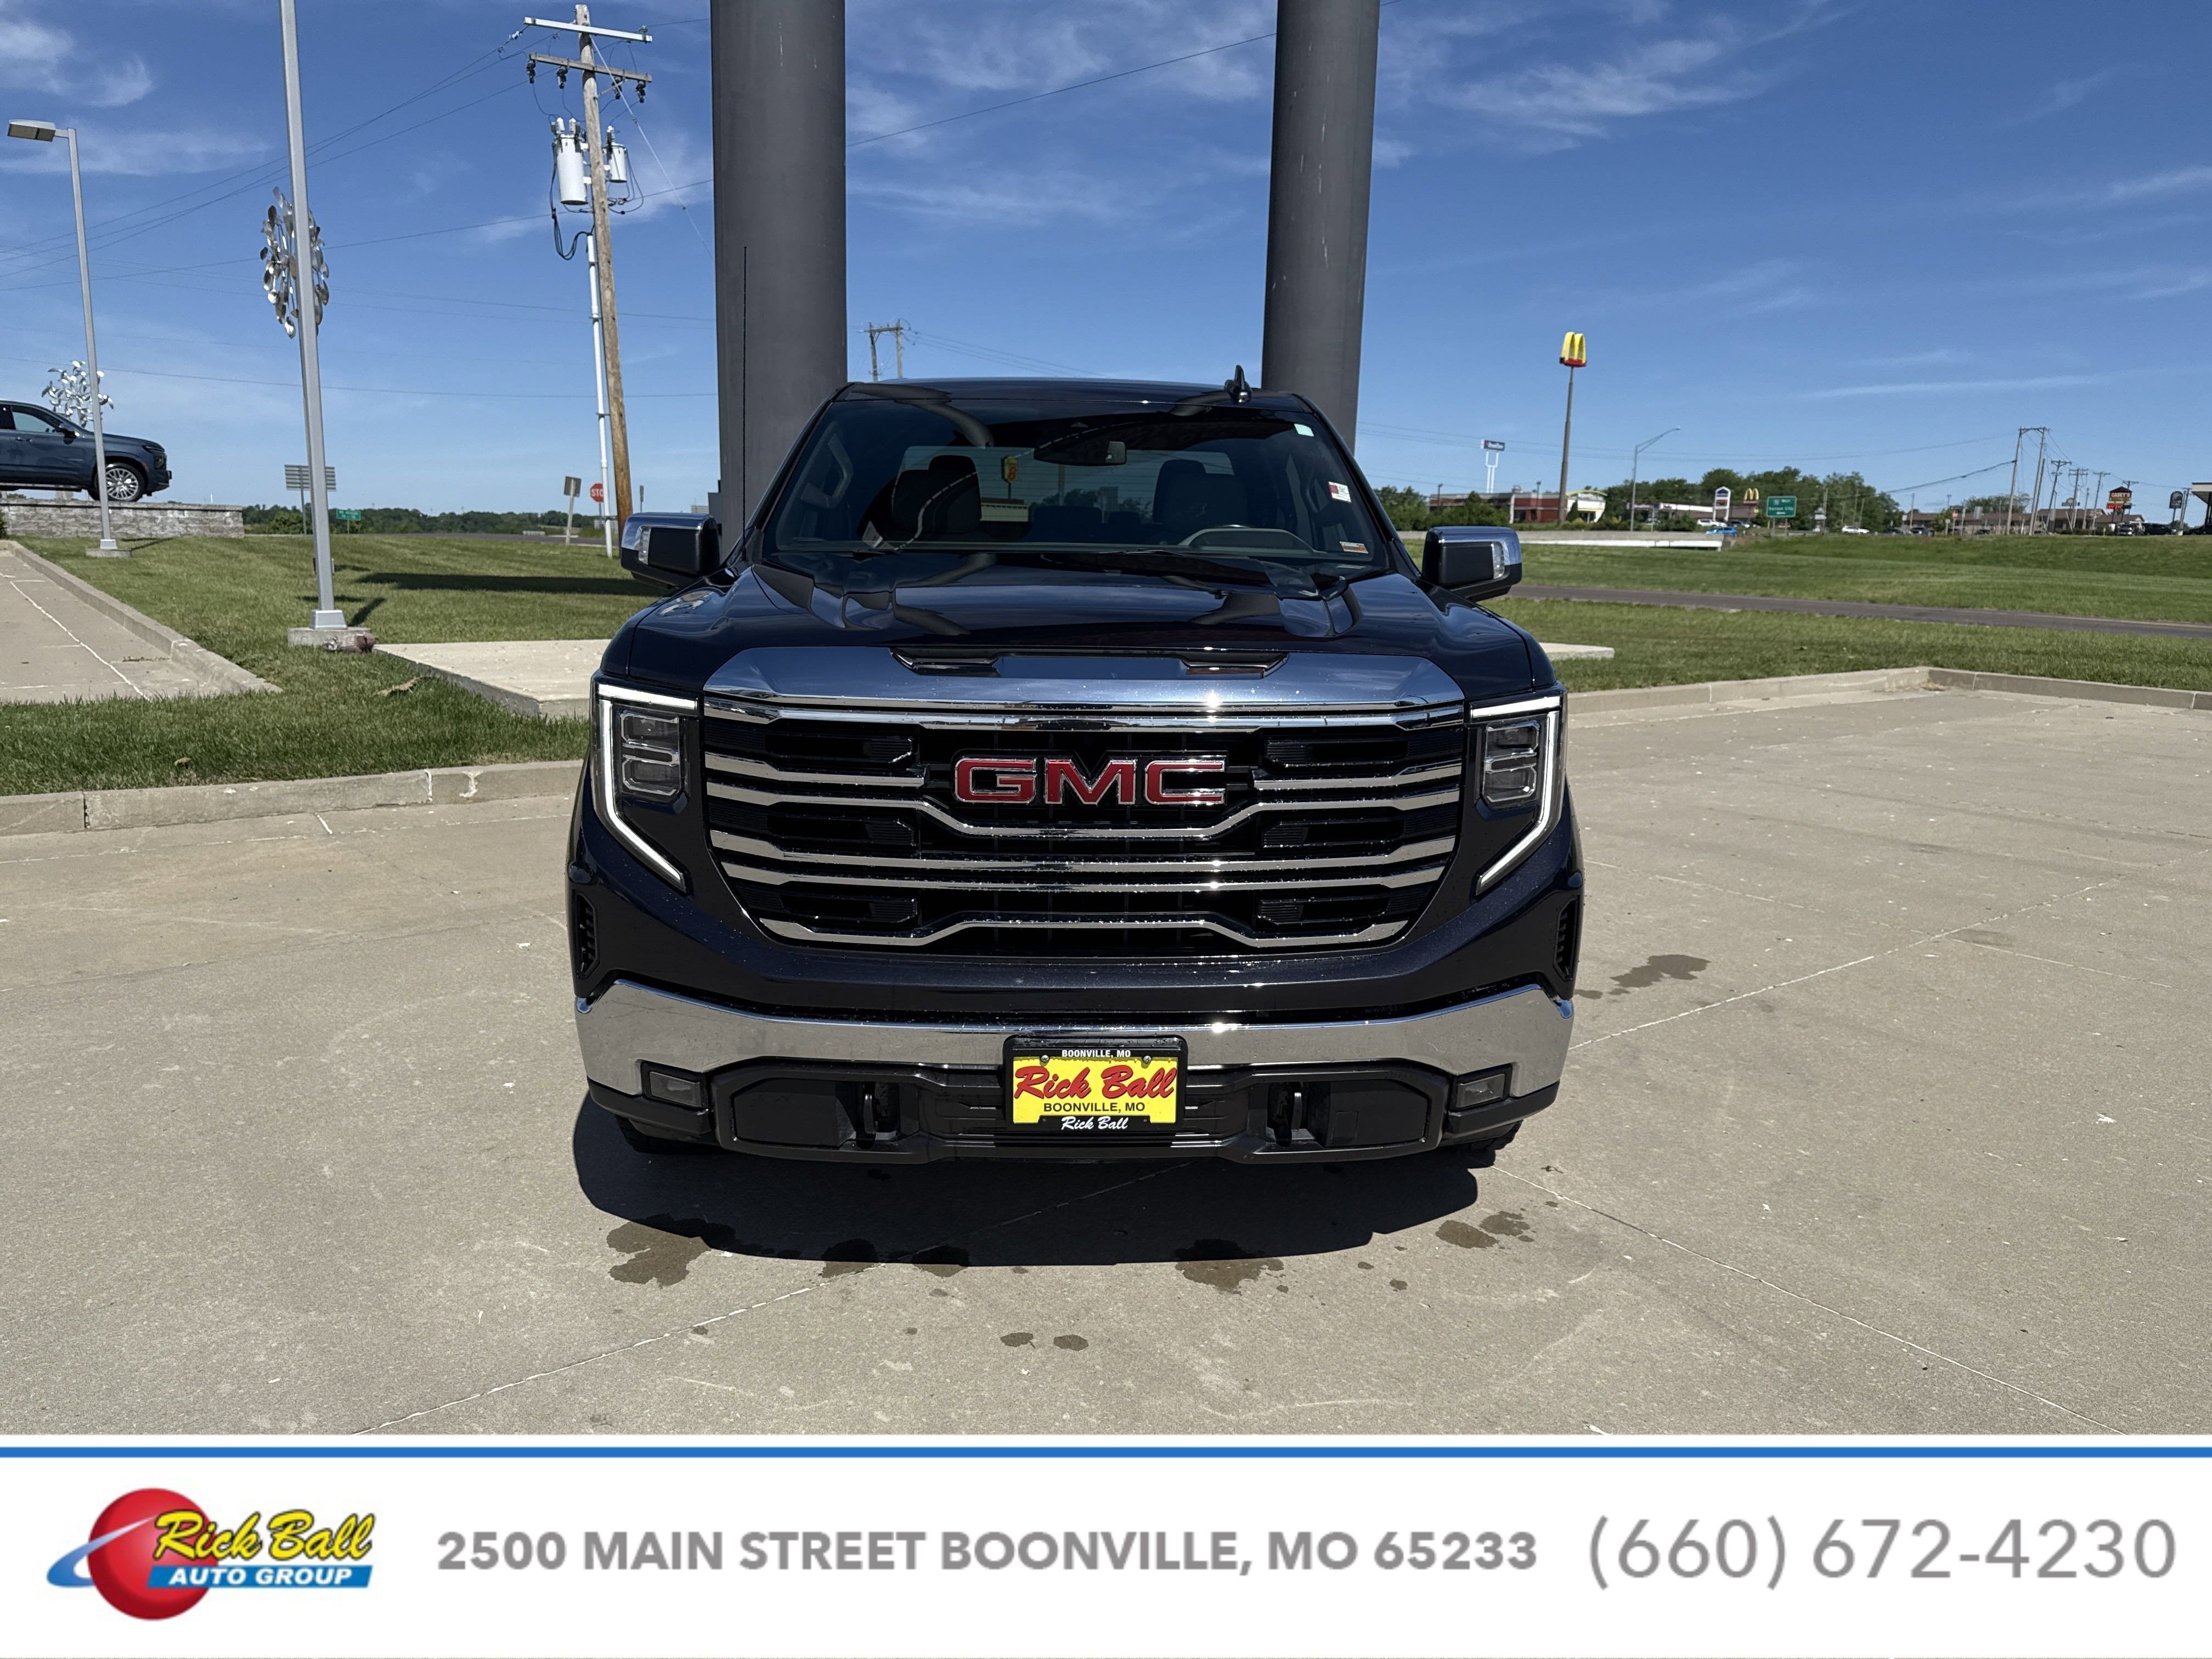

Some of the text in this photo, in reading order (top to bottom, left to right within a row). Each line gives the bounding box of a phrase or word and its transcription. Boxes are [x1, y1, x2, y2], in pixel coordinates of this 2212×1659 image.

[591, 489, 604, 497] STO
[955, 758, 1226, 805] GMC
[1062, 1049, 1131, 1058] BOONVILLE, MO
[1014, 1065, 1177, 1099] Rick Ball
[1043, 1102, 1146, 1113] BOONVILLE, MO
[1061, 1116, 1128, 1130] Rick Ball
